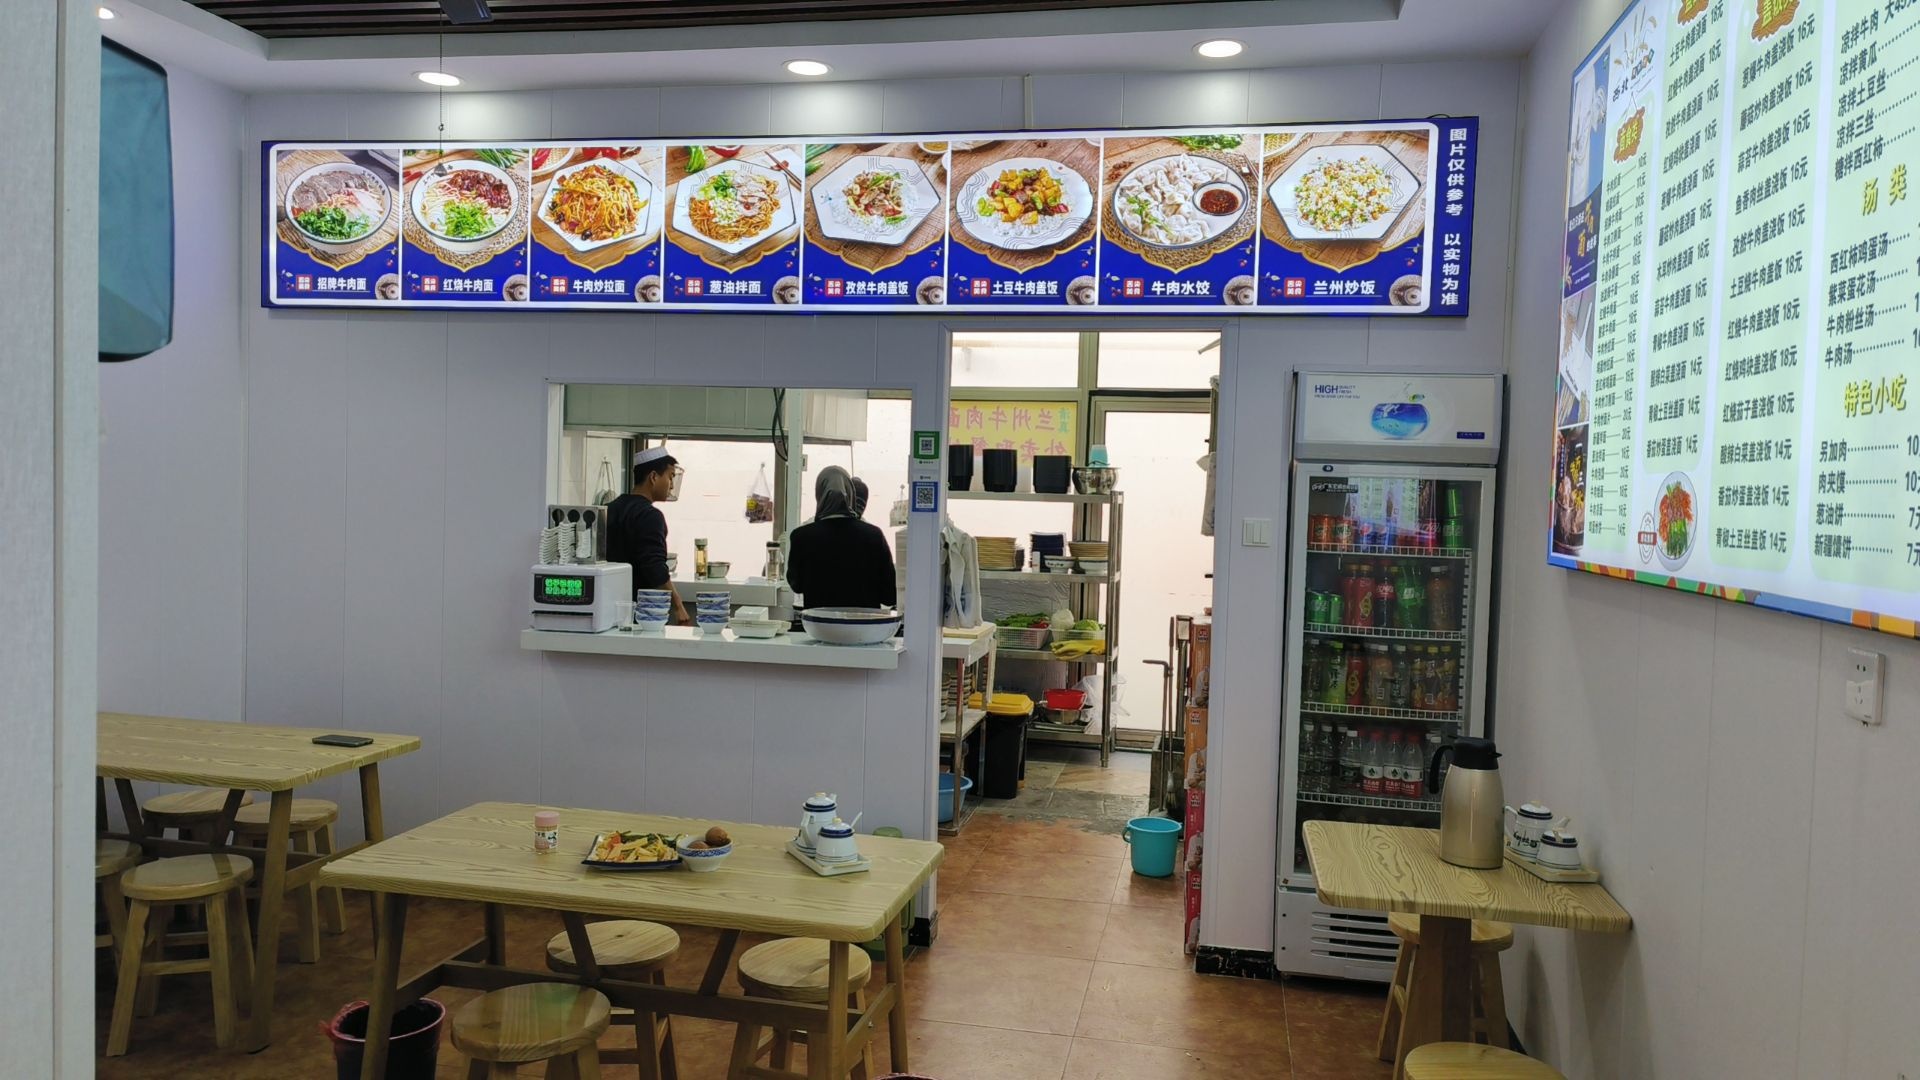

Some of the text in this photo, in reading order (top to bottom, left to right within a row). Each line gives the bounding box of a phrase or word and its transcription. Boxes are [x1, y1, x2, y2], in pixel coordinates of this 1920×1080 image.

[1670, 14, 1707, 67] 土豆牛肉盖浇面
[1798, 13, 1815, 42] 16元
[1841, 8, 1879, 54] 凉拌牛肉
[1668, 52, 1705, 102] 红烧牛肉盖浇面
[1840, 41, 1877, 86] 凉拌黄瓜
[1740, 61, 1813, 131] 蘑菇炒肉盖浇饭 16元
[1838, 68, 1886, 117] 凉拌土豆丝
[1666, 91, 1703, 140] 孜然牛肉盖浇面
[1793, 108, 1810, 136] 16元
[1836, 108, 1874, 149] 凉拌三丝
[1663, 130, 1701, 174] 红烧鸡块盖浇面
[1834, 134, 1883, 182] 糖拌西红柿
[1735, 156, 1808, 215] 鱼香肉丝盖浇饭 16元
[1441, 127, 1467, 306] 图片仅供参考 以实物为准
[1659, 207, 1696, 246] 蘑菇炒肉盖浇面
[1733, 203, 1805, 257] 孜然牛肉盖浇饭 18元
[1657, 246, 1694, 281] 木耳炒肉盖浇面
[1830, 232, 1888, 275] 西红柿鸡蛋汤
[318, 277, 367, 291] 招牌牛肉面
[443, 279, 494, 292] 红烧牛肉面
[573, 279, 626, 293] 牛肉炒拉面
[709, 280, 762, 295] 葱油拌面
[846, 280, 909, 296] 孜然牛肉盖饭
[992, 280, 1058, 296] 土豆牛肉盖饭
[1151, 280, 1210, 296] 牛肉水饺
[1313, 280, 1375, 295] 兰州炒饭
[1730, 251, 1802, 299] 土豆烧牛肉盖饭 18元
[1828, 270, 1876, 307] 紫菜蛋花汤
[1728, 298, 1800, 340] 红烧牛肉盖浇饭 18元
[1826, 303, 1874, 338] 牛肉粉丝汤
[1653, 322, 1689, 353] 青椒牛肉盖浇面
[1725, 345, 1797, 381] 红烧鸡块盖浇饭 18元
[1825, 341, 1852, 370] 牛肉汤
[1315, 385, 1338, 393] HIGH
[1650, 360, 1687, 388] 酸辣白菜盖浇面
[1649, 398, 1685, 423] 青椒土豆丝盖面
[1723, 392, 1794, 422] 红烧茄子盖浇饭 18元
[1844, 374, 1907, 418] 特色小吃
[1647, 436, 1682, 458] 番茄炒蛋盖浇面
[1720, 439, 1792, 464] 酸辣白菜盖浇饭 14元
[1819, 435, 1920, 462] 另加肉 10
[1718, 485, 1789, 507] 番茄炒蛋盖浇饭 14元
[1818, 470, 1846, 494] 肉夹馍
[1816, 502, 1844, 526] 葱油饼
[1716, 528, 1786, 553] 青椒土豆丝盖饭 14元
